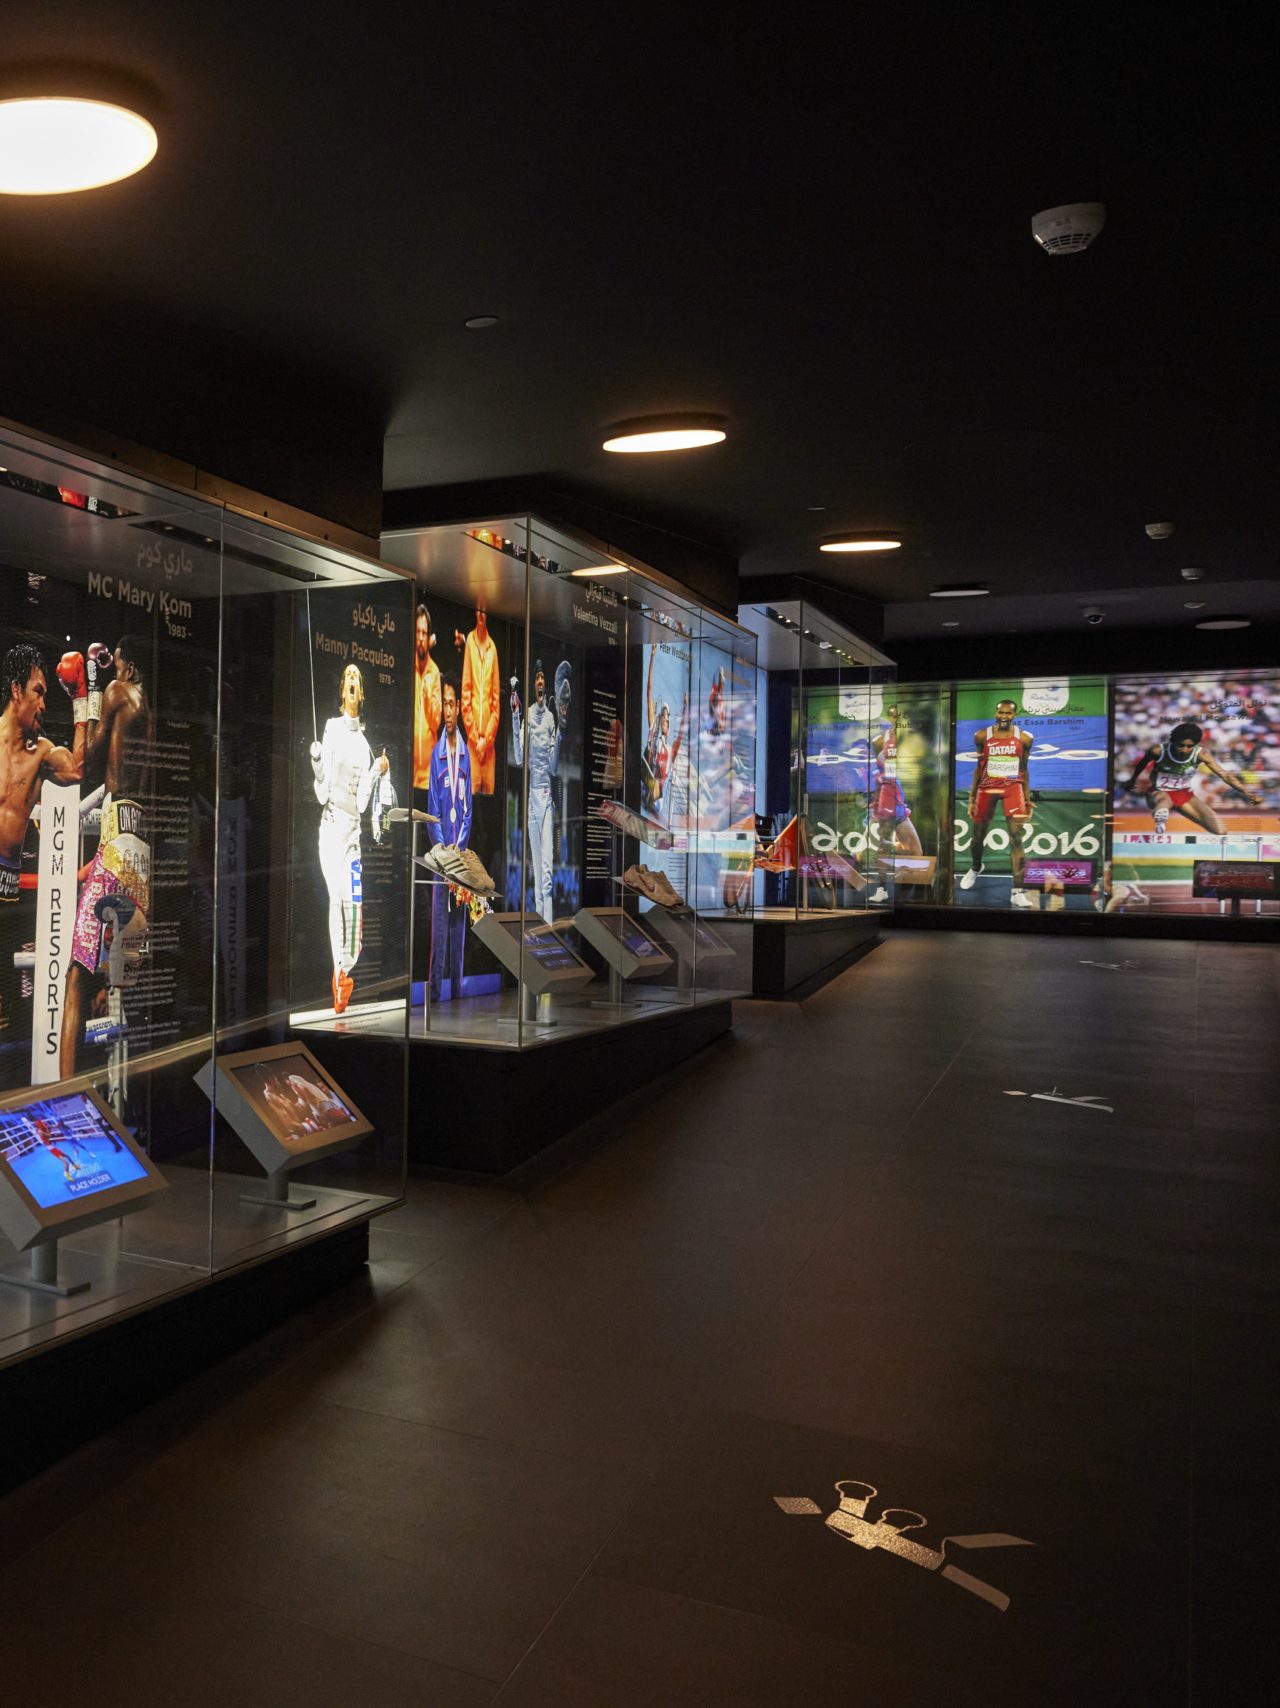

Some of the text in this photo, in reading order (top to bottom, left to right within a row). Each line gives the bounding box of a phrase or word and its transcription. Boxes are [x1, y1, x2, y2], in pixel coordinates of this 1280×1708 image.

[137, 541, 193, 580] ماري كوم
[88, 571, 192, 618] MC Mary Kom
[168, 623, 187, 638] 1983
[573, 604, 618, 635] Valentina Vezzali
[315, 632, 395, 669] Manny Pacquiao
[1047, 718, 1085, 726] Barshim
[989, 745, 1017, 756] QATAR
[1022, 823, 1100, 856] 2016
[46, 806, 66, 1055] MGM RESORTS
[70, 1173, 112, 1193] PLACE HOLDER
